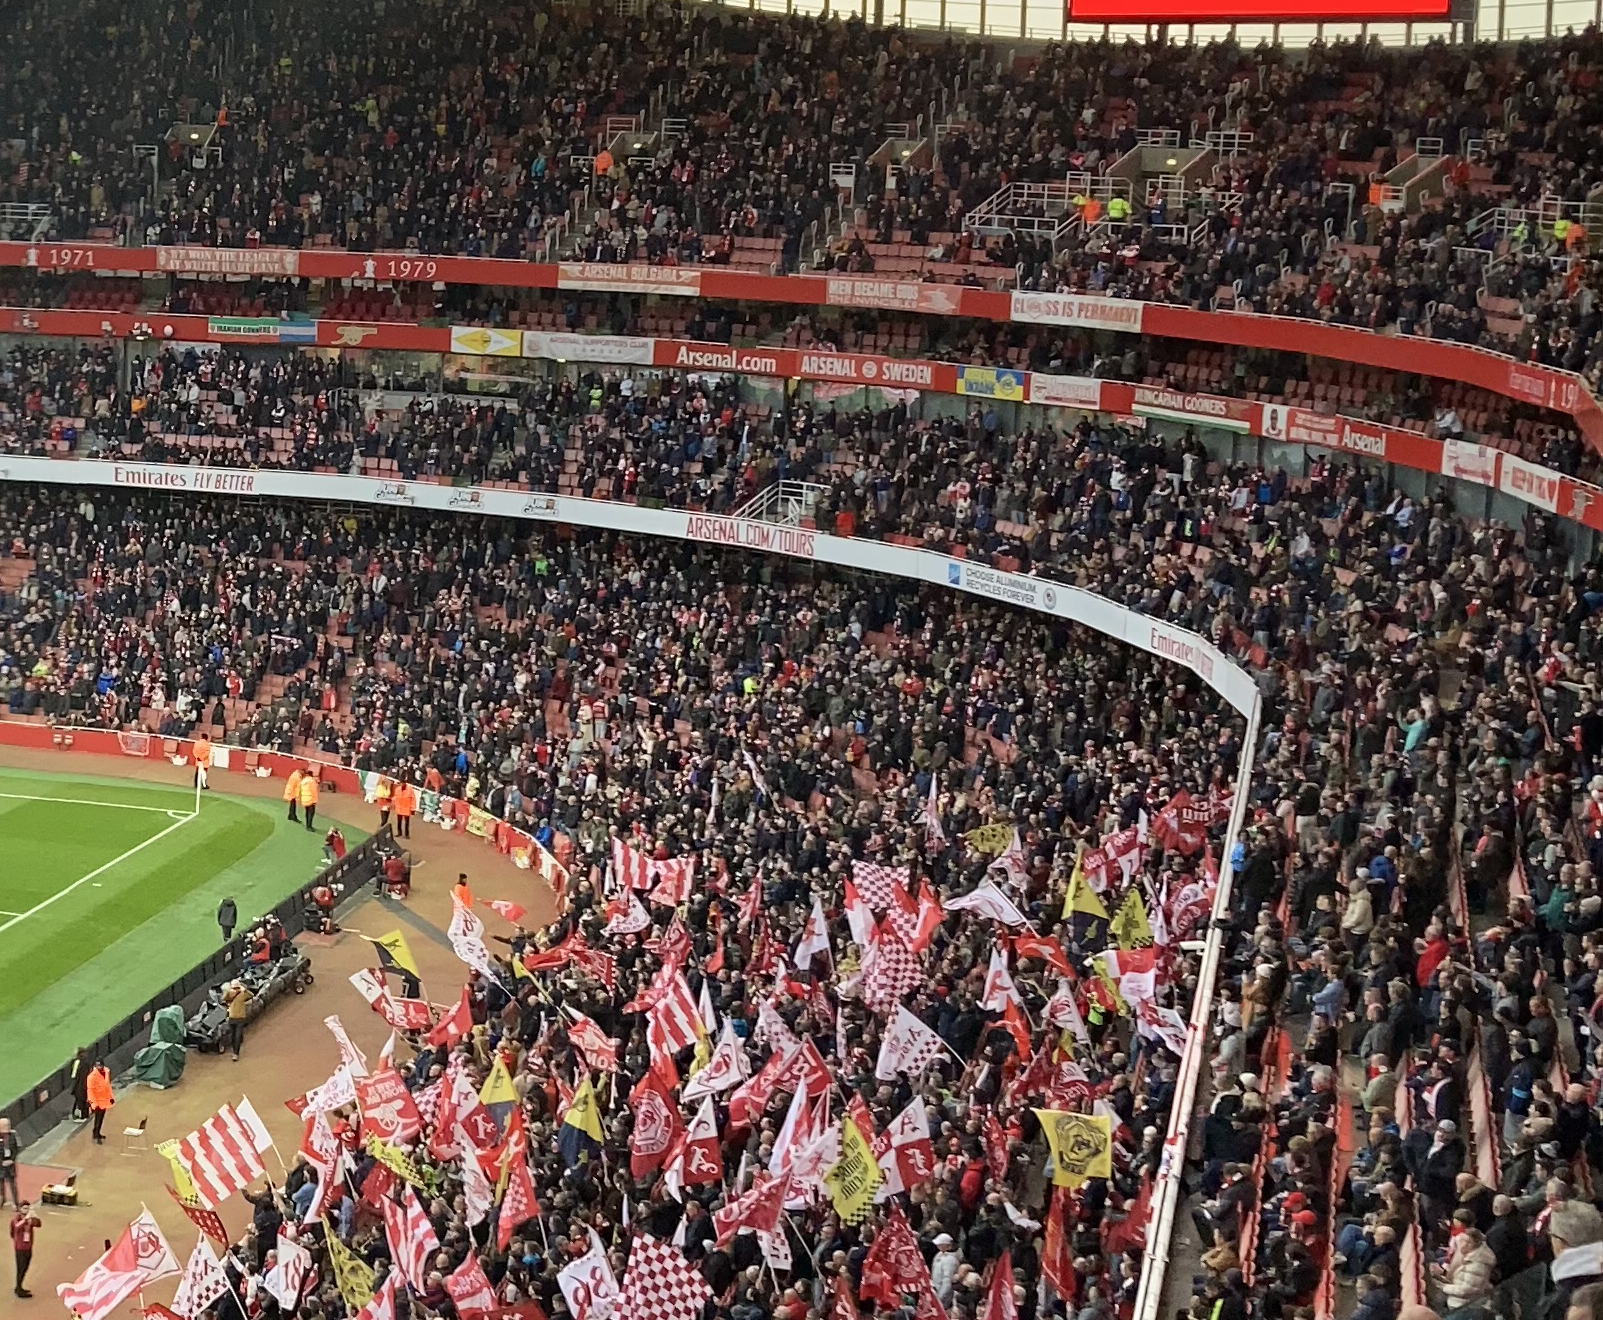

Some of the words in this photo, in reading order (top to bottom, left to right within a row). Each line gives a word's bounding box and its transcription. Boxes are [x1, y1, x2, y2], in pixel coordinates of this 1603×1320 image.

[49, 249, 95, 265] 1971
[185, 260, 218, 271] WHITE
[221, 261, 252, 272] HART
[254, 262, 280, 273] LANE
[189, 250, 209, 261] WON
[215, 251, 236, 261] THE
[239, 251, 280, 263] LEAGUE
[388, 261, 437, 278] 1979
[584, 265, 627, 279] ARSENAL
[630, 266, 678, 282] BULGARIA
[828, 280, 852, 297] MEN
[854, 281, 895, 298] BECAME
[1013, 299, 1059, 318] CLSS
[1061, 301, 1074, 317] IS
[1076, 302, 1140, 326] PERMANENT
[676, 345, 776, 373] Arsenal.com
[801, 356, 857, 377] ARSENAL
[882, 362, 932, 385] SWEDEN
[1134, 387, 1183, 407] HUNGARIAN
[1184, 395, 1227, 416] GOONERS
[1342, 423, 1386, 456] Arsenal
[114, 467, 187, 488] Emirates
[193, 472, 213, 490] FLY
[214, 473, 254, 492] BETTER
[686, 516, 815, 556] ARSENAL.COM/TOURS
[966, 567, 995, 585] CHOOSE
[965, 578, 1001, 597] RECYCLES
[283, 1253, 302, 1293] 18
